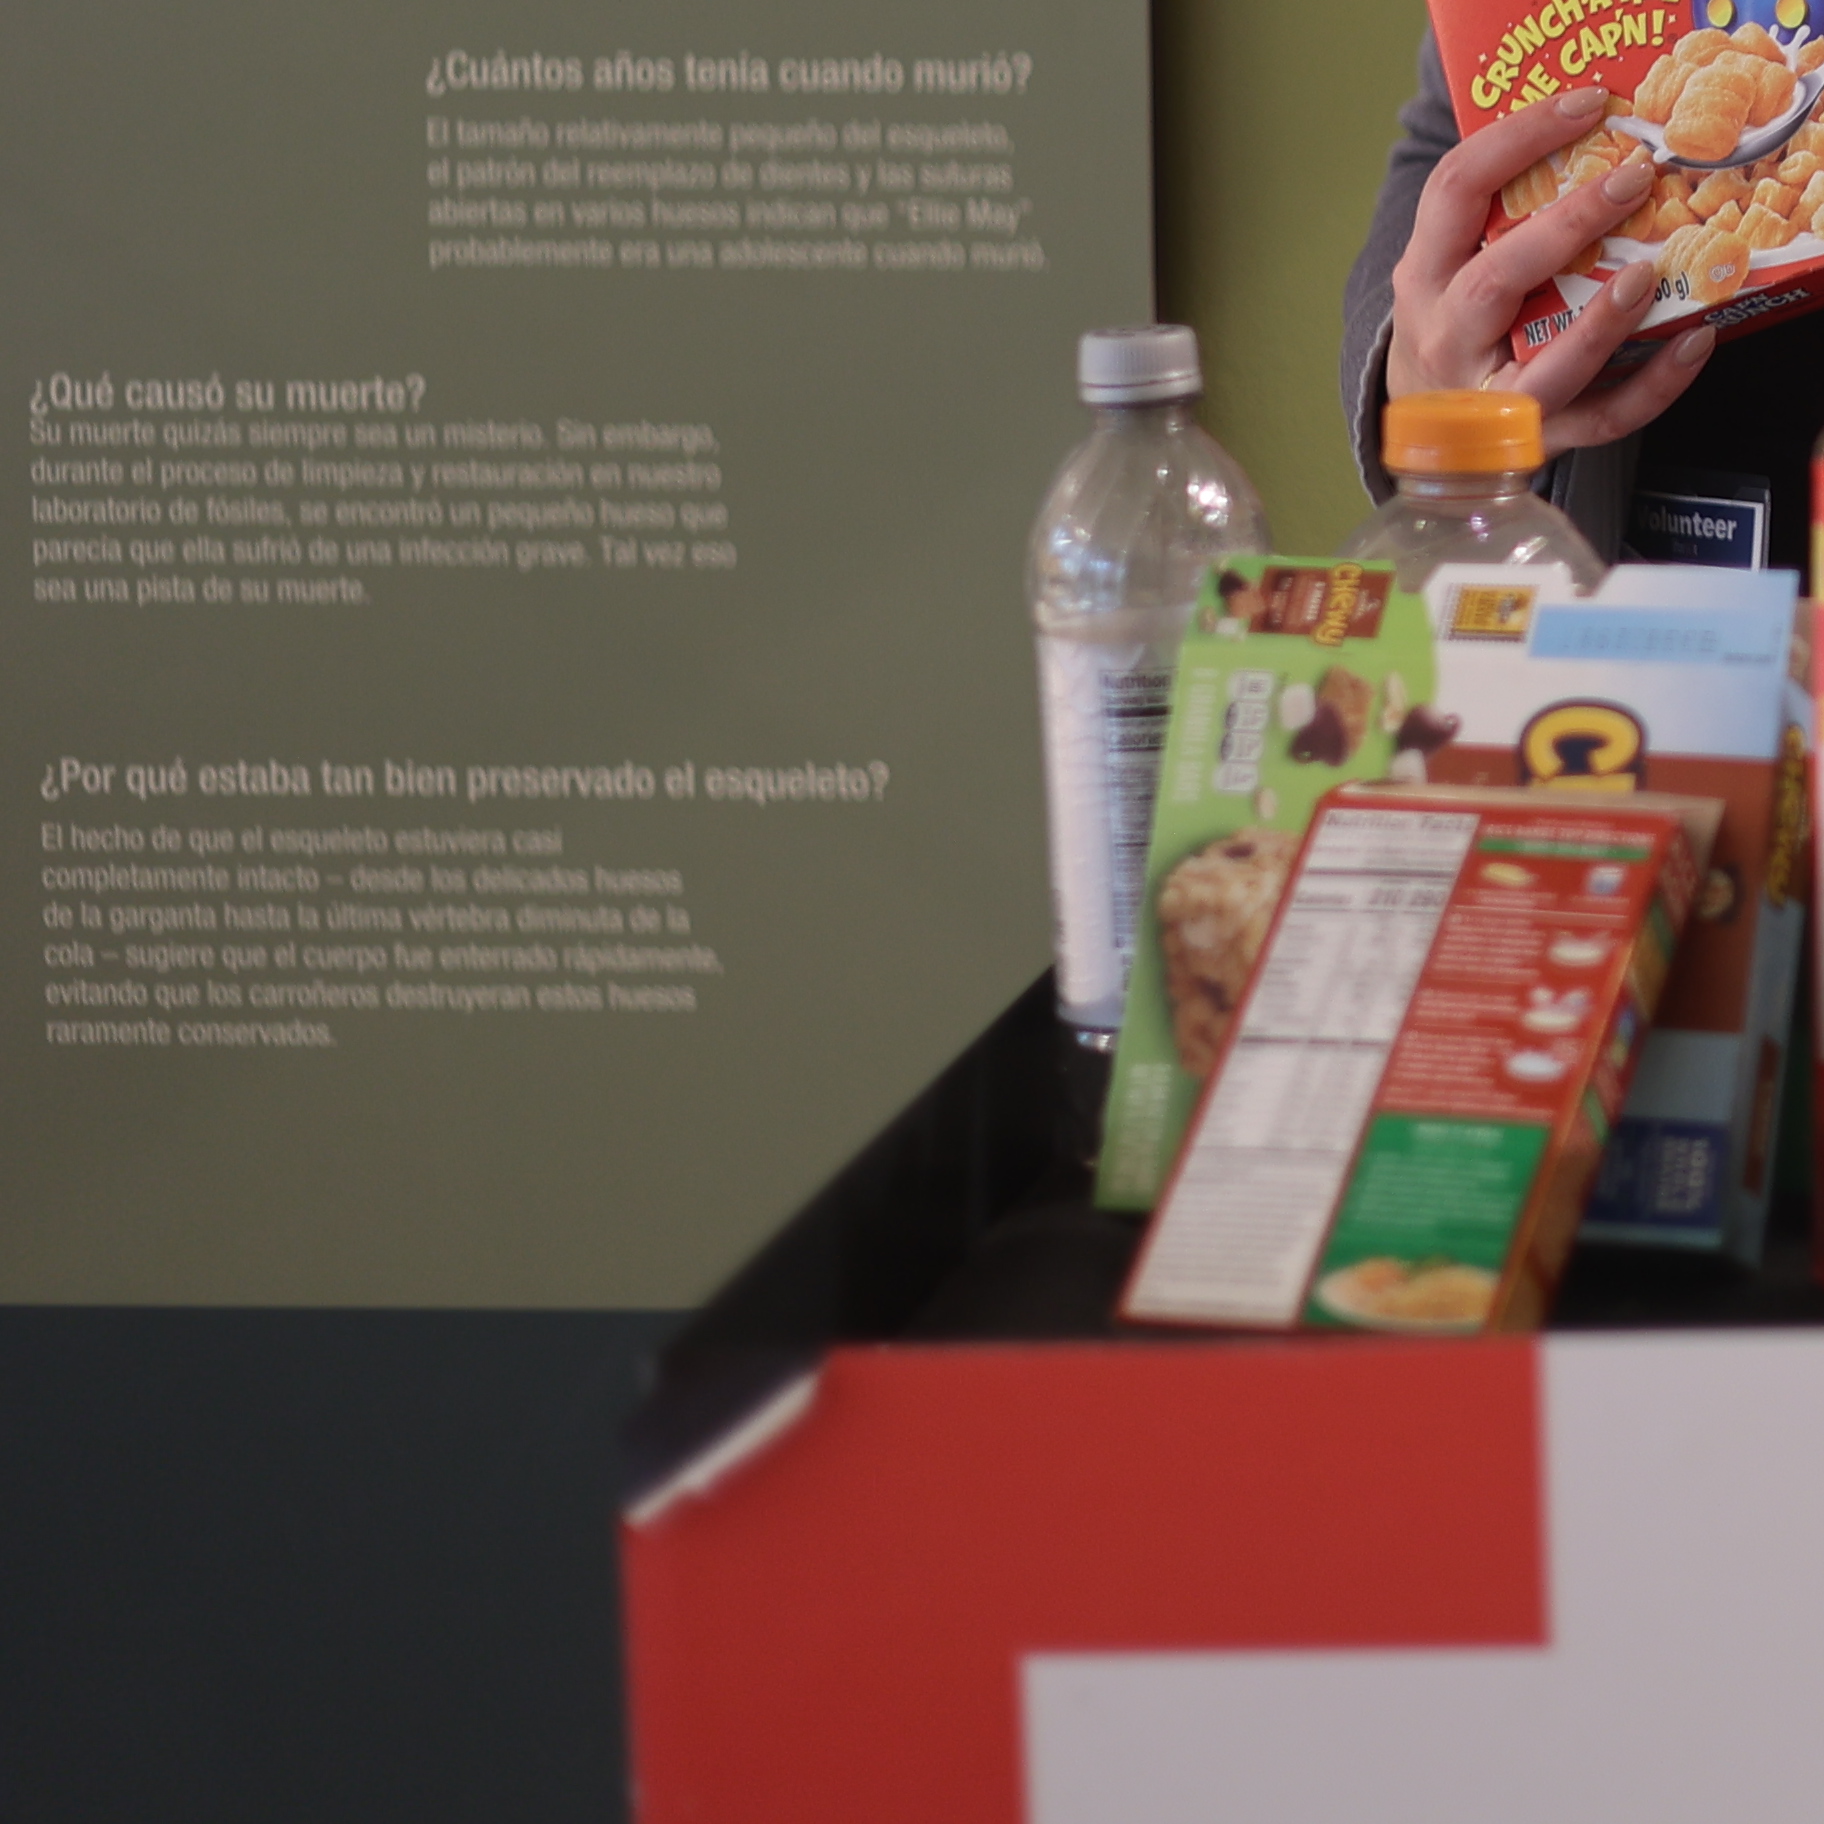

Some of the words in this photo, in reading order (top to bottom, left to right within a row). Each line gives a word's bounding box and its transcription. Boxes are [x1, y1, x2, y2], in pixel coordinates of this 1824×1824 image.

[1524, 316, 1552, 348] NET
[30, 372, 114, 415] ¿Qué
[125, 372, 225, 410] causó
[236, 381, 274, 410] su
[287, 374, 425, 411] muerte?
[40, 757, 116, 800] ¿Por
[126, 757, 187, 800] qué
[199, 759, 311, 795] estaba
[321, 760, 374, 795] tan
[385, 760, 456, 796] bien
[467, 761, 655, 803] preservado
[664, 761, 695, 797] el
[705, 761, 889, 805] esqueleto?
